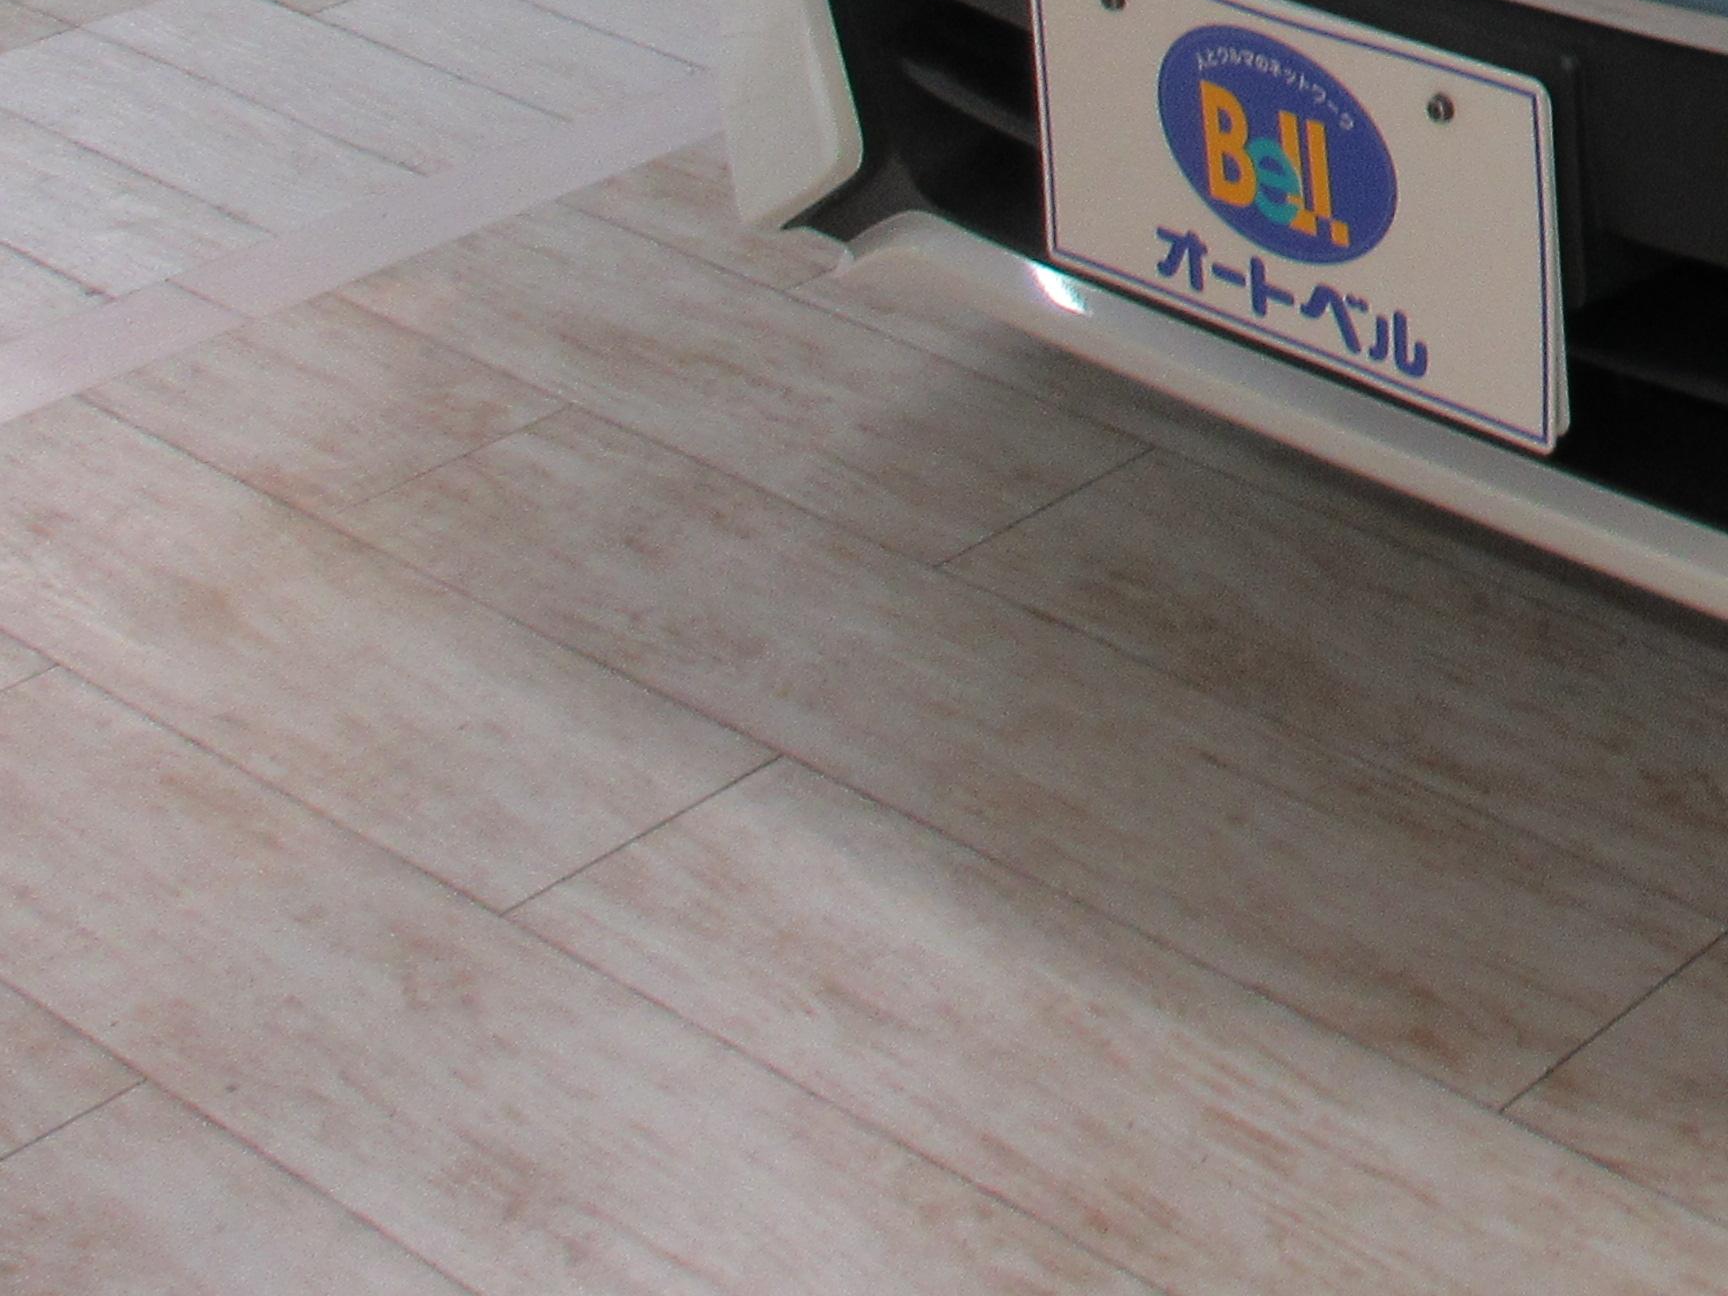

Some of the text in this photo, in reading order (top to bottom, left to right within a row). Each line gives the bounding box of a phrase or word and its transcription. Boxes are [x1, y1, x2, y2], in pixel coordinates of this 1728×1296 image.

[1155, 226, 1428, 377] オートベル
